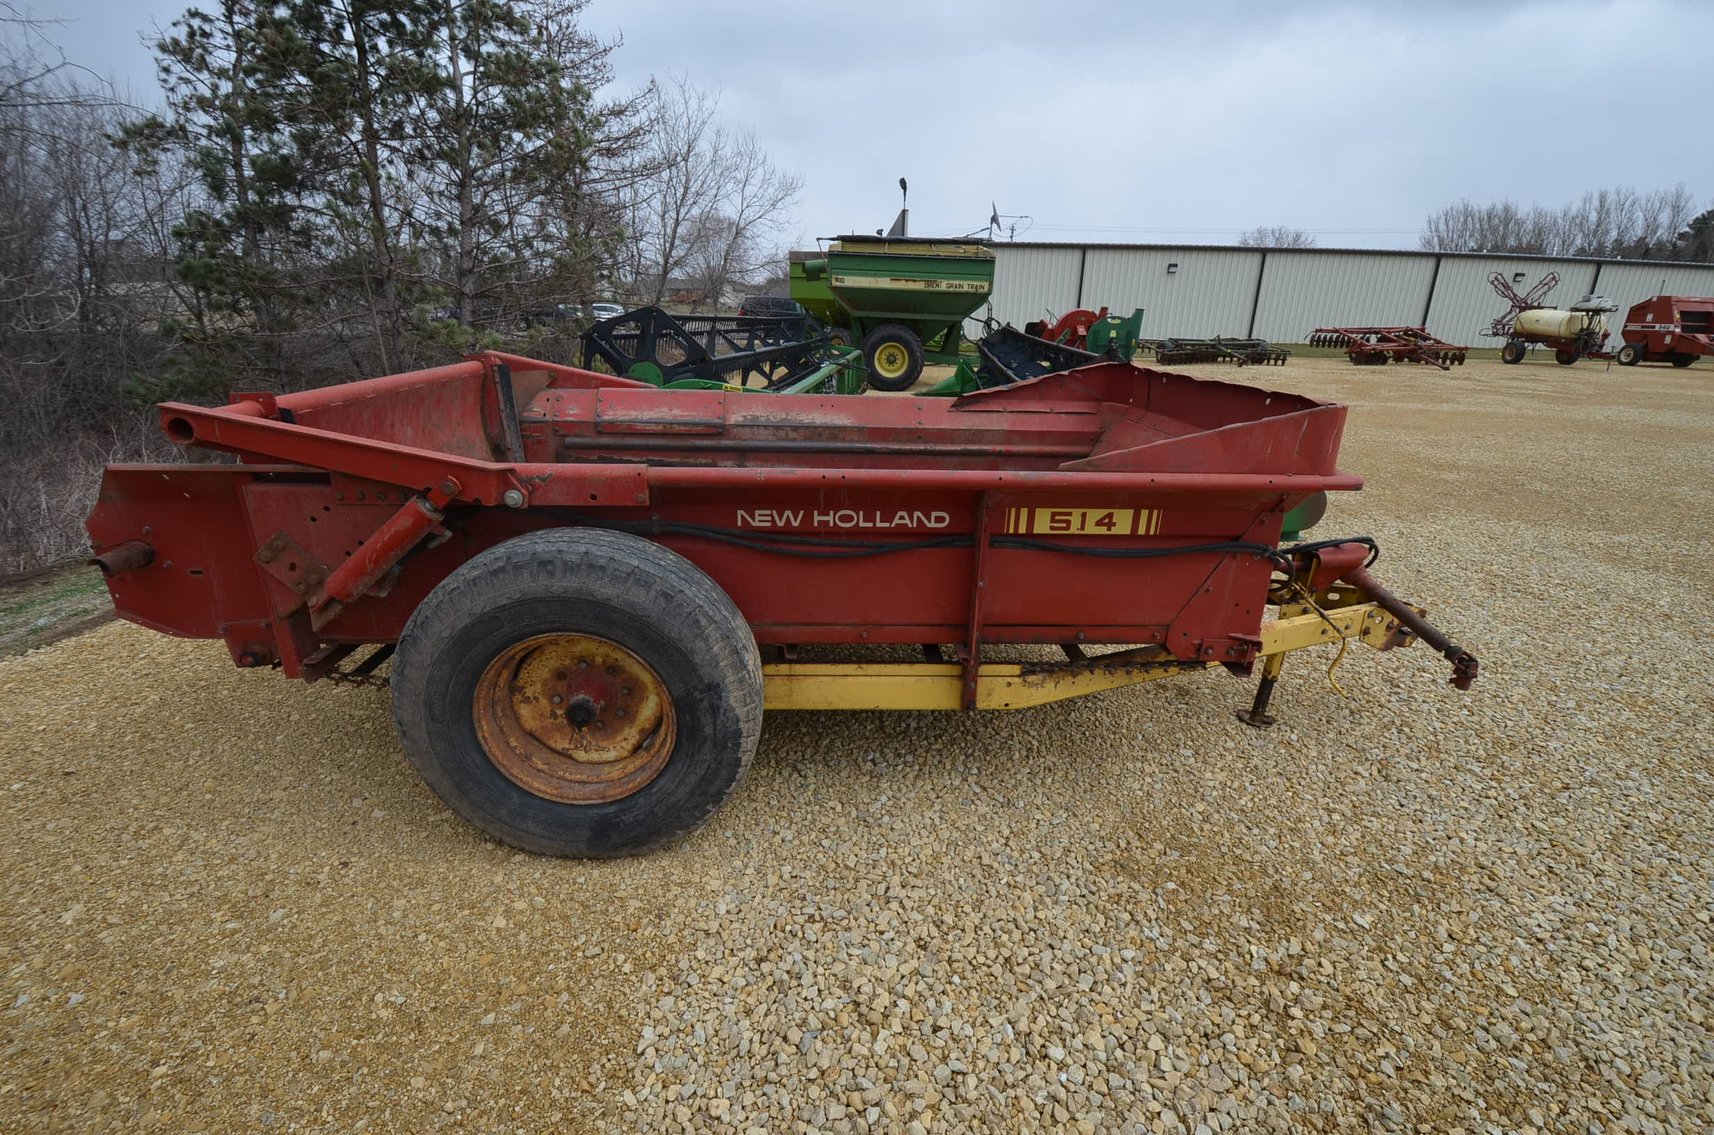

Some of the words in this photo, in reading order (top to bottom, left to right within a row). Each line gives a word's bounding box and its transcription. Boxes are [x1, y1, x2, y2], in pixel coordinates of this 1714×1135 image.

[945, 282, 964, 290] GRAIN
[966, 283, 985, 291] TRAIN
[737, 510, 803, 528] NEW
[812, 510, 951, 529] HOLLAND
[1049, 511, 1117, 532] 514
